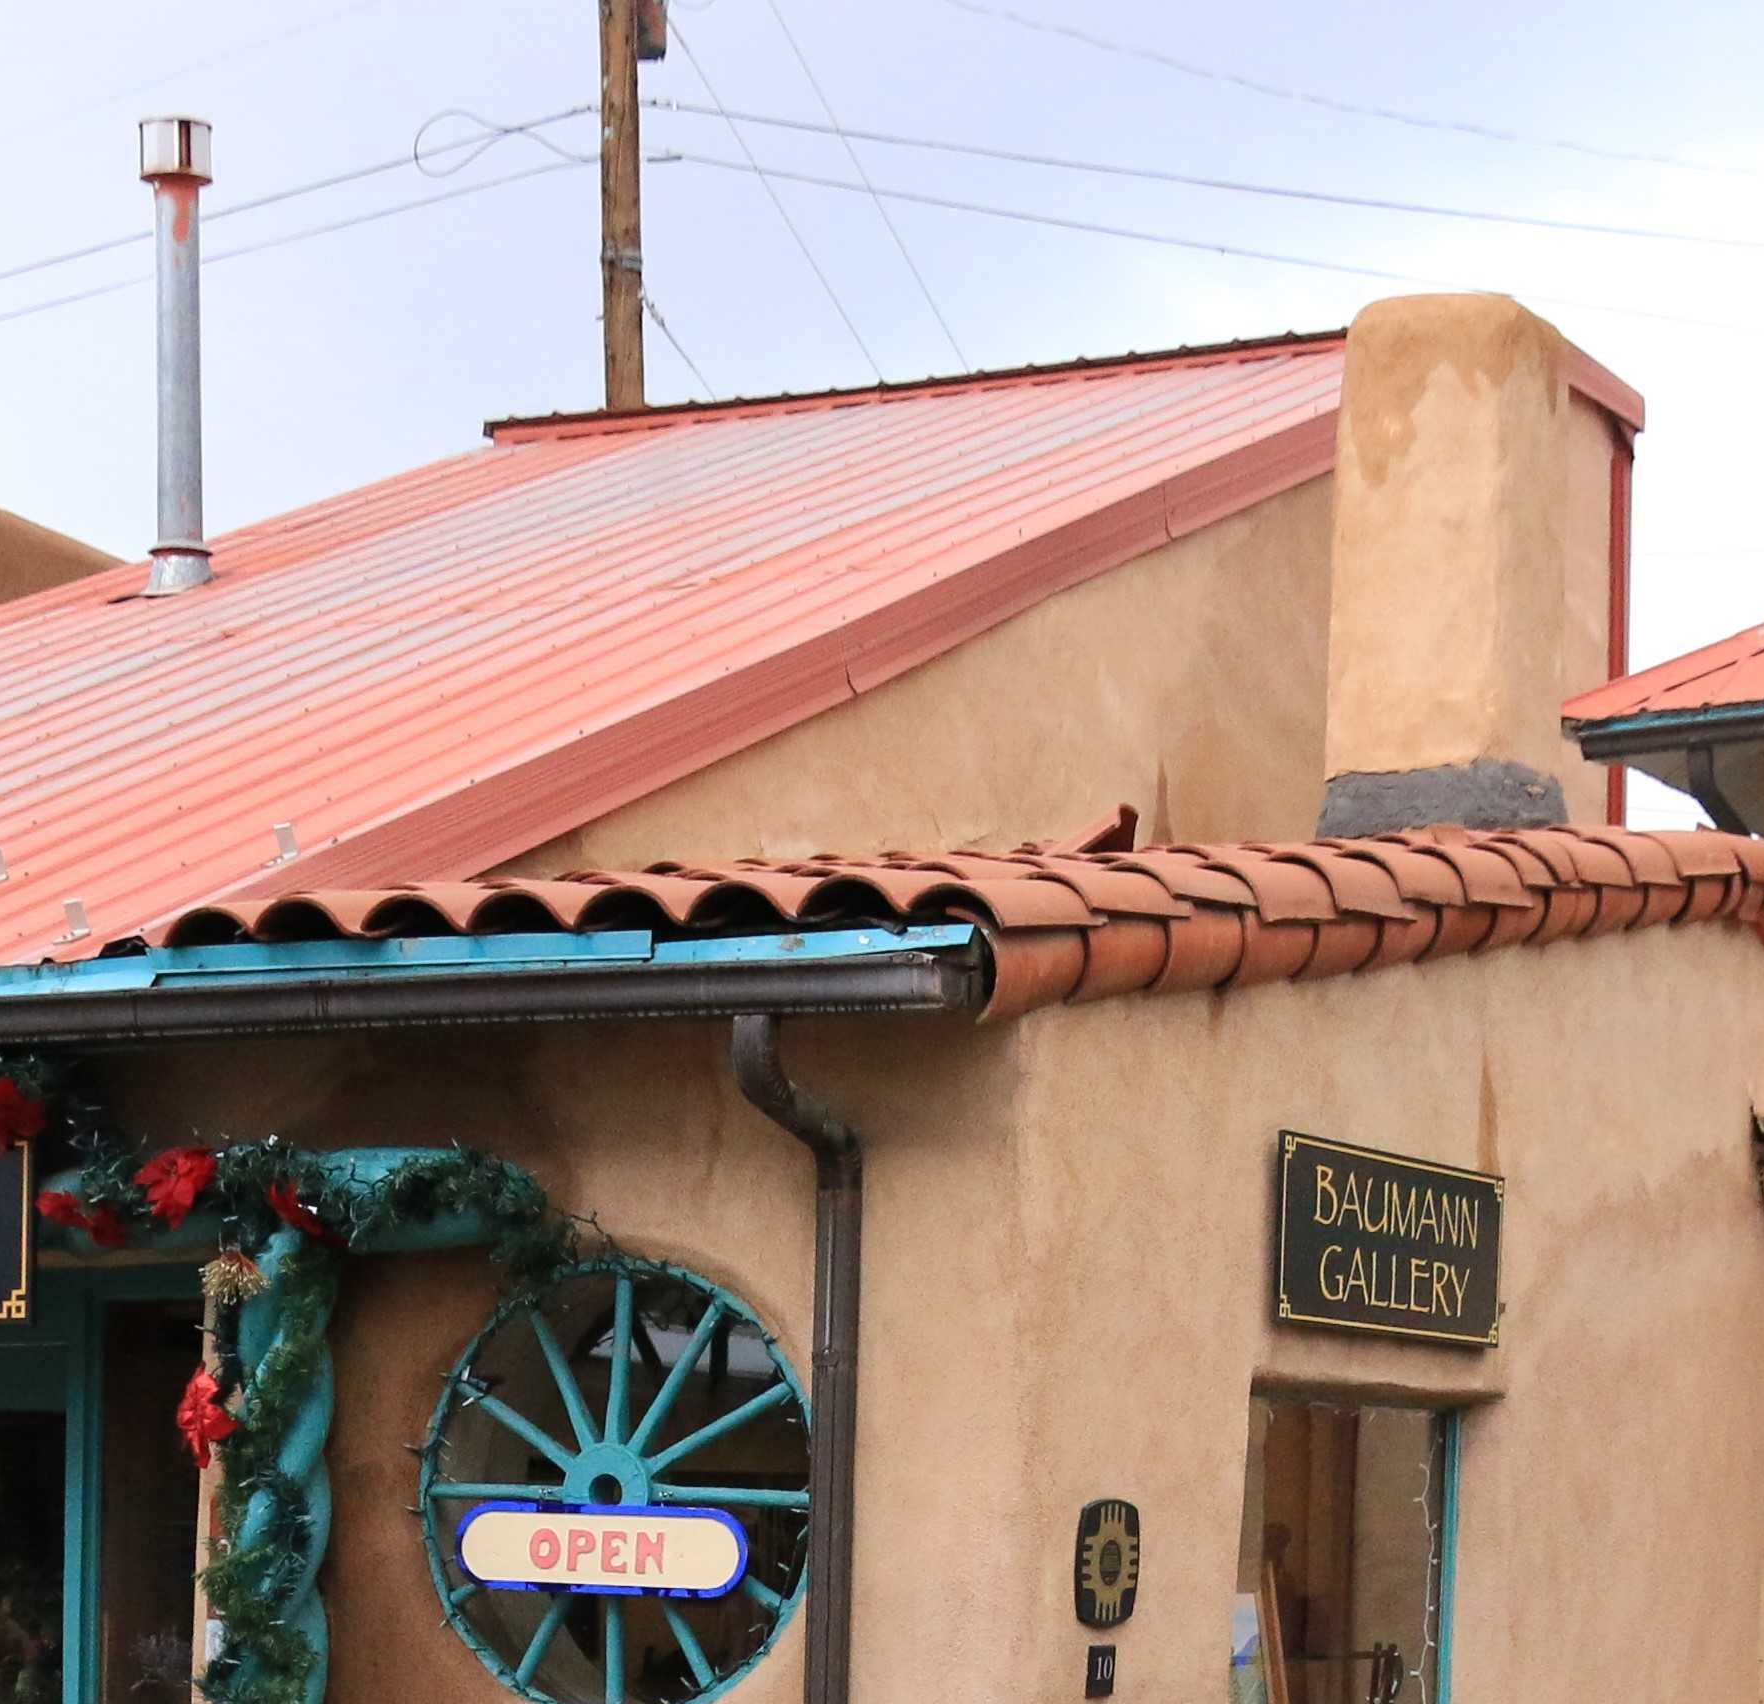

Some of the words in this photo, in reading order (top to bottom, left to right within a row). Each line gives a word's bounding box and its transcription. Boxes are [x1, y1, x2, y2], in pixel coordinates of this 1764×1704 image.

[1313, 1164, 1479, 1250] BAUMANN
[1320, 1245, 1470, 1318] GALLERY
[528, 1528, 666, 1575] OPEN
[1095, 1655, 1113, 1681] 10
